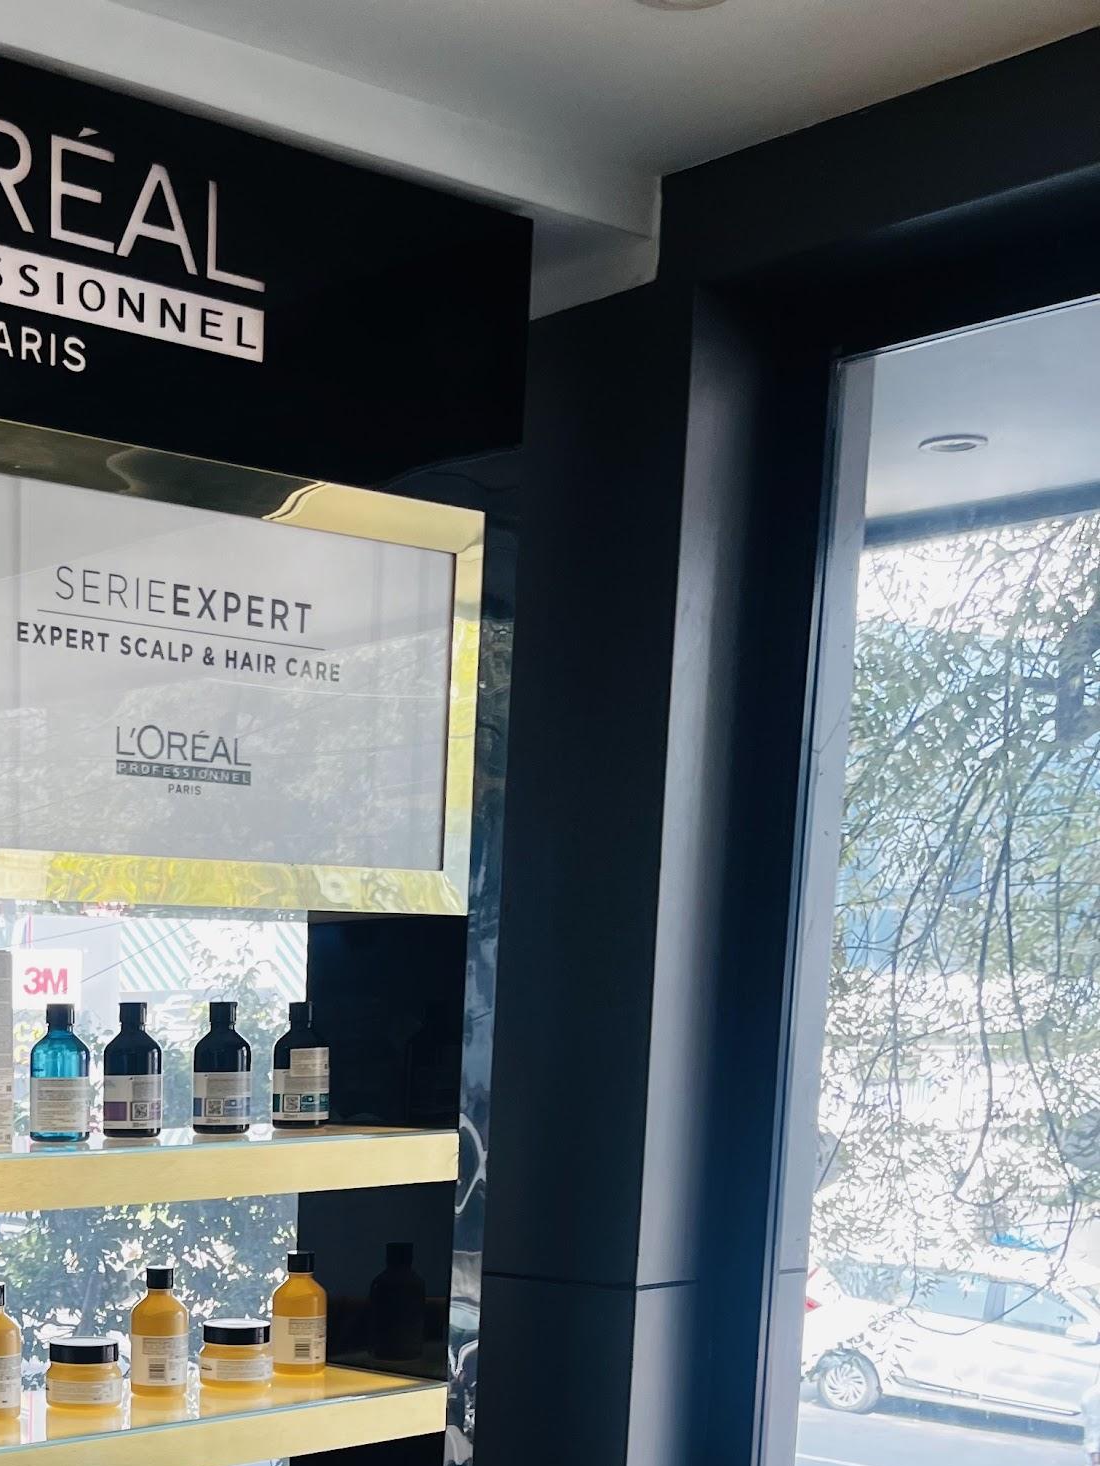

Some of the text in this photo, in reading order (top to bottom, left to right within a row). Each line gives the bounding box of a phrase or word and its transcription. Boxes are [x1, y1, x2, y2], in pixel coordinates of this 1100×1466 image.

[16, 620, 341, 683] EXPERT SCALP & HAIR CARE
[116, 724, 252, 767] L'ORÉAL
[117, 761, 250, 785] PROFESSIONNEL
[168, 783, 202, 796] PARIS
[23, 967, 68, 997] 3M
